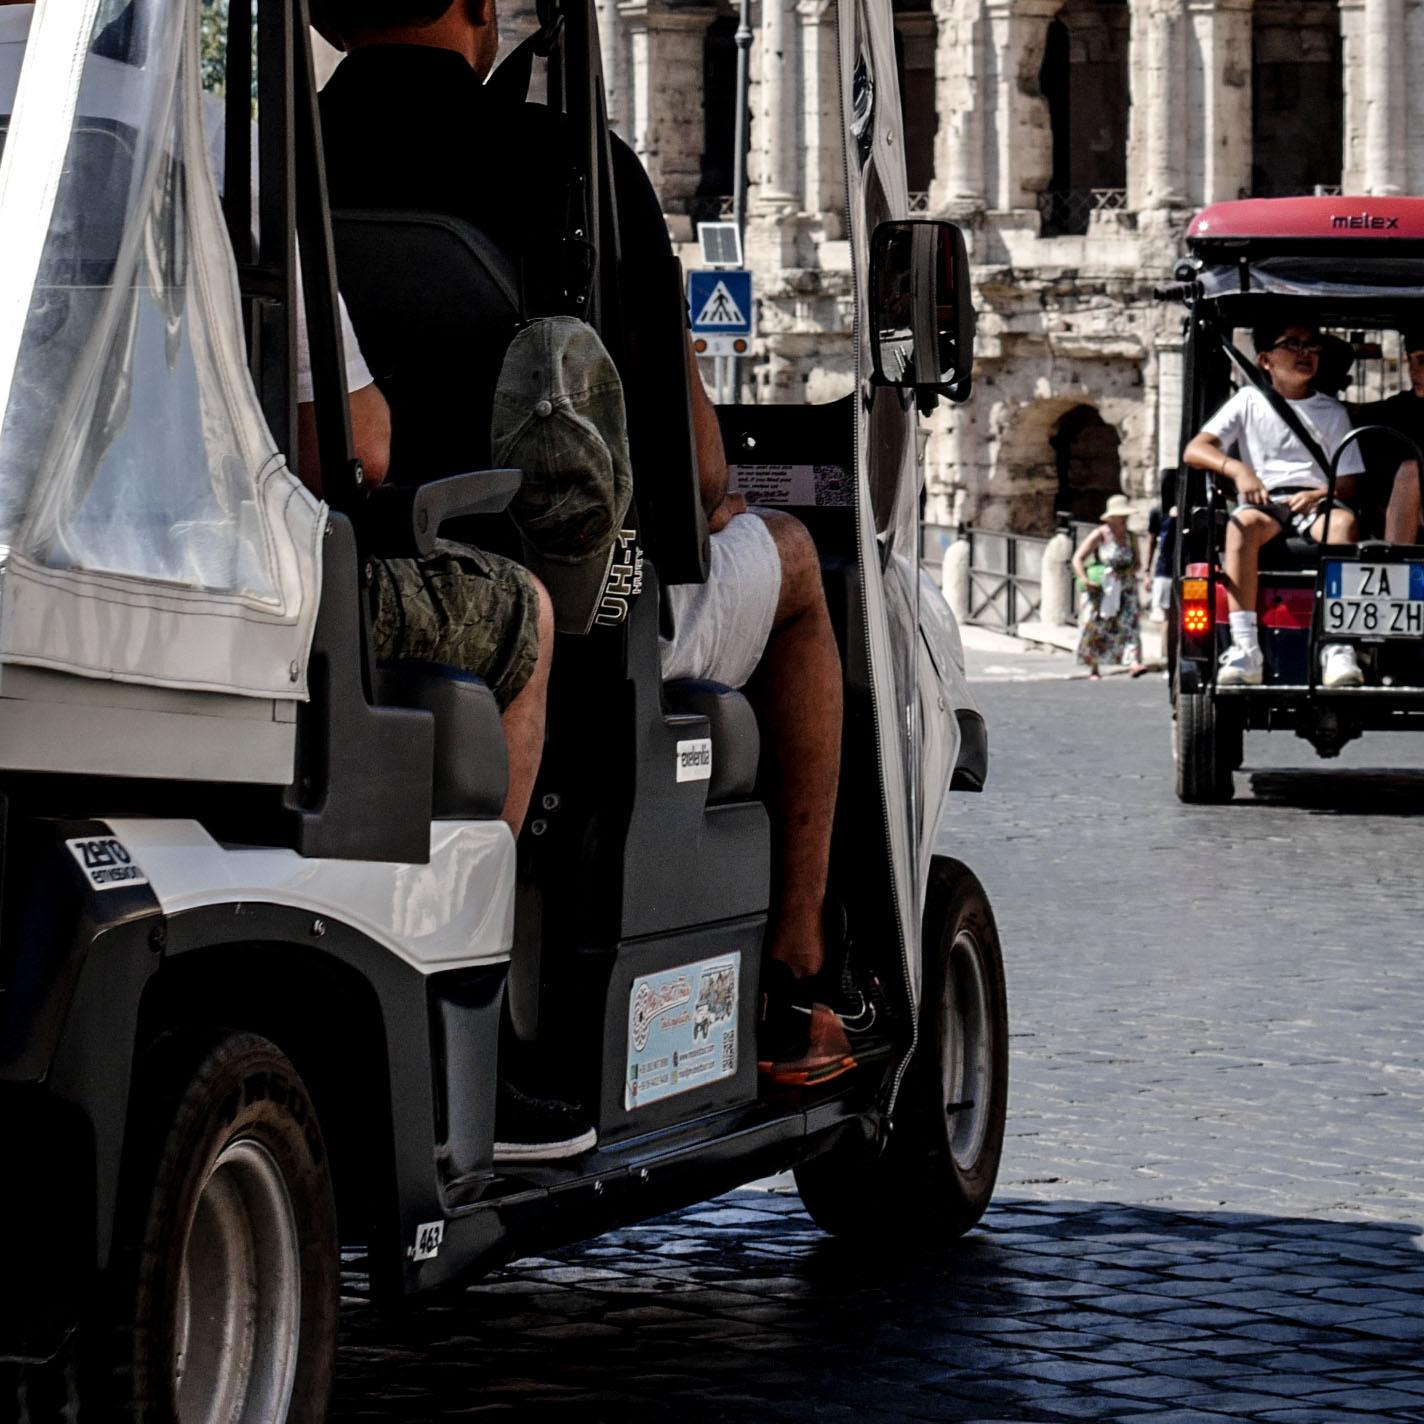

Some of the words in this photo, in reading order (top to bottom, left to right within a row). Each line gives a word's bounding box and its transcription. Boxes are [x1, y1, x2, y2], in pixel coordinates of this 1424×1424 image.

[1332, 213, 1399, 230] melex
[594, 529, 637, 627] UH-1
[1360, 567, 1391, 596] ZA
[1329, 602, 1378, 630] 978
[1390, 603, 1422, 632] ZH
[74, 839, 132, 869] zero
[419, 1226, 440, 1254] 463
